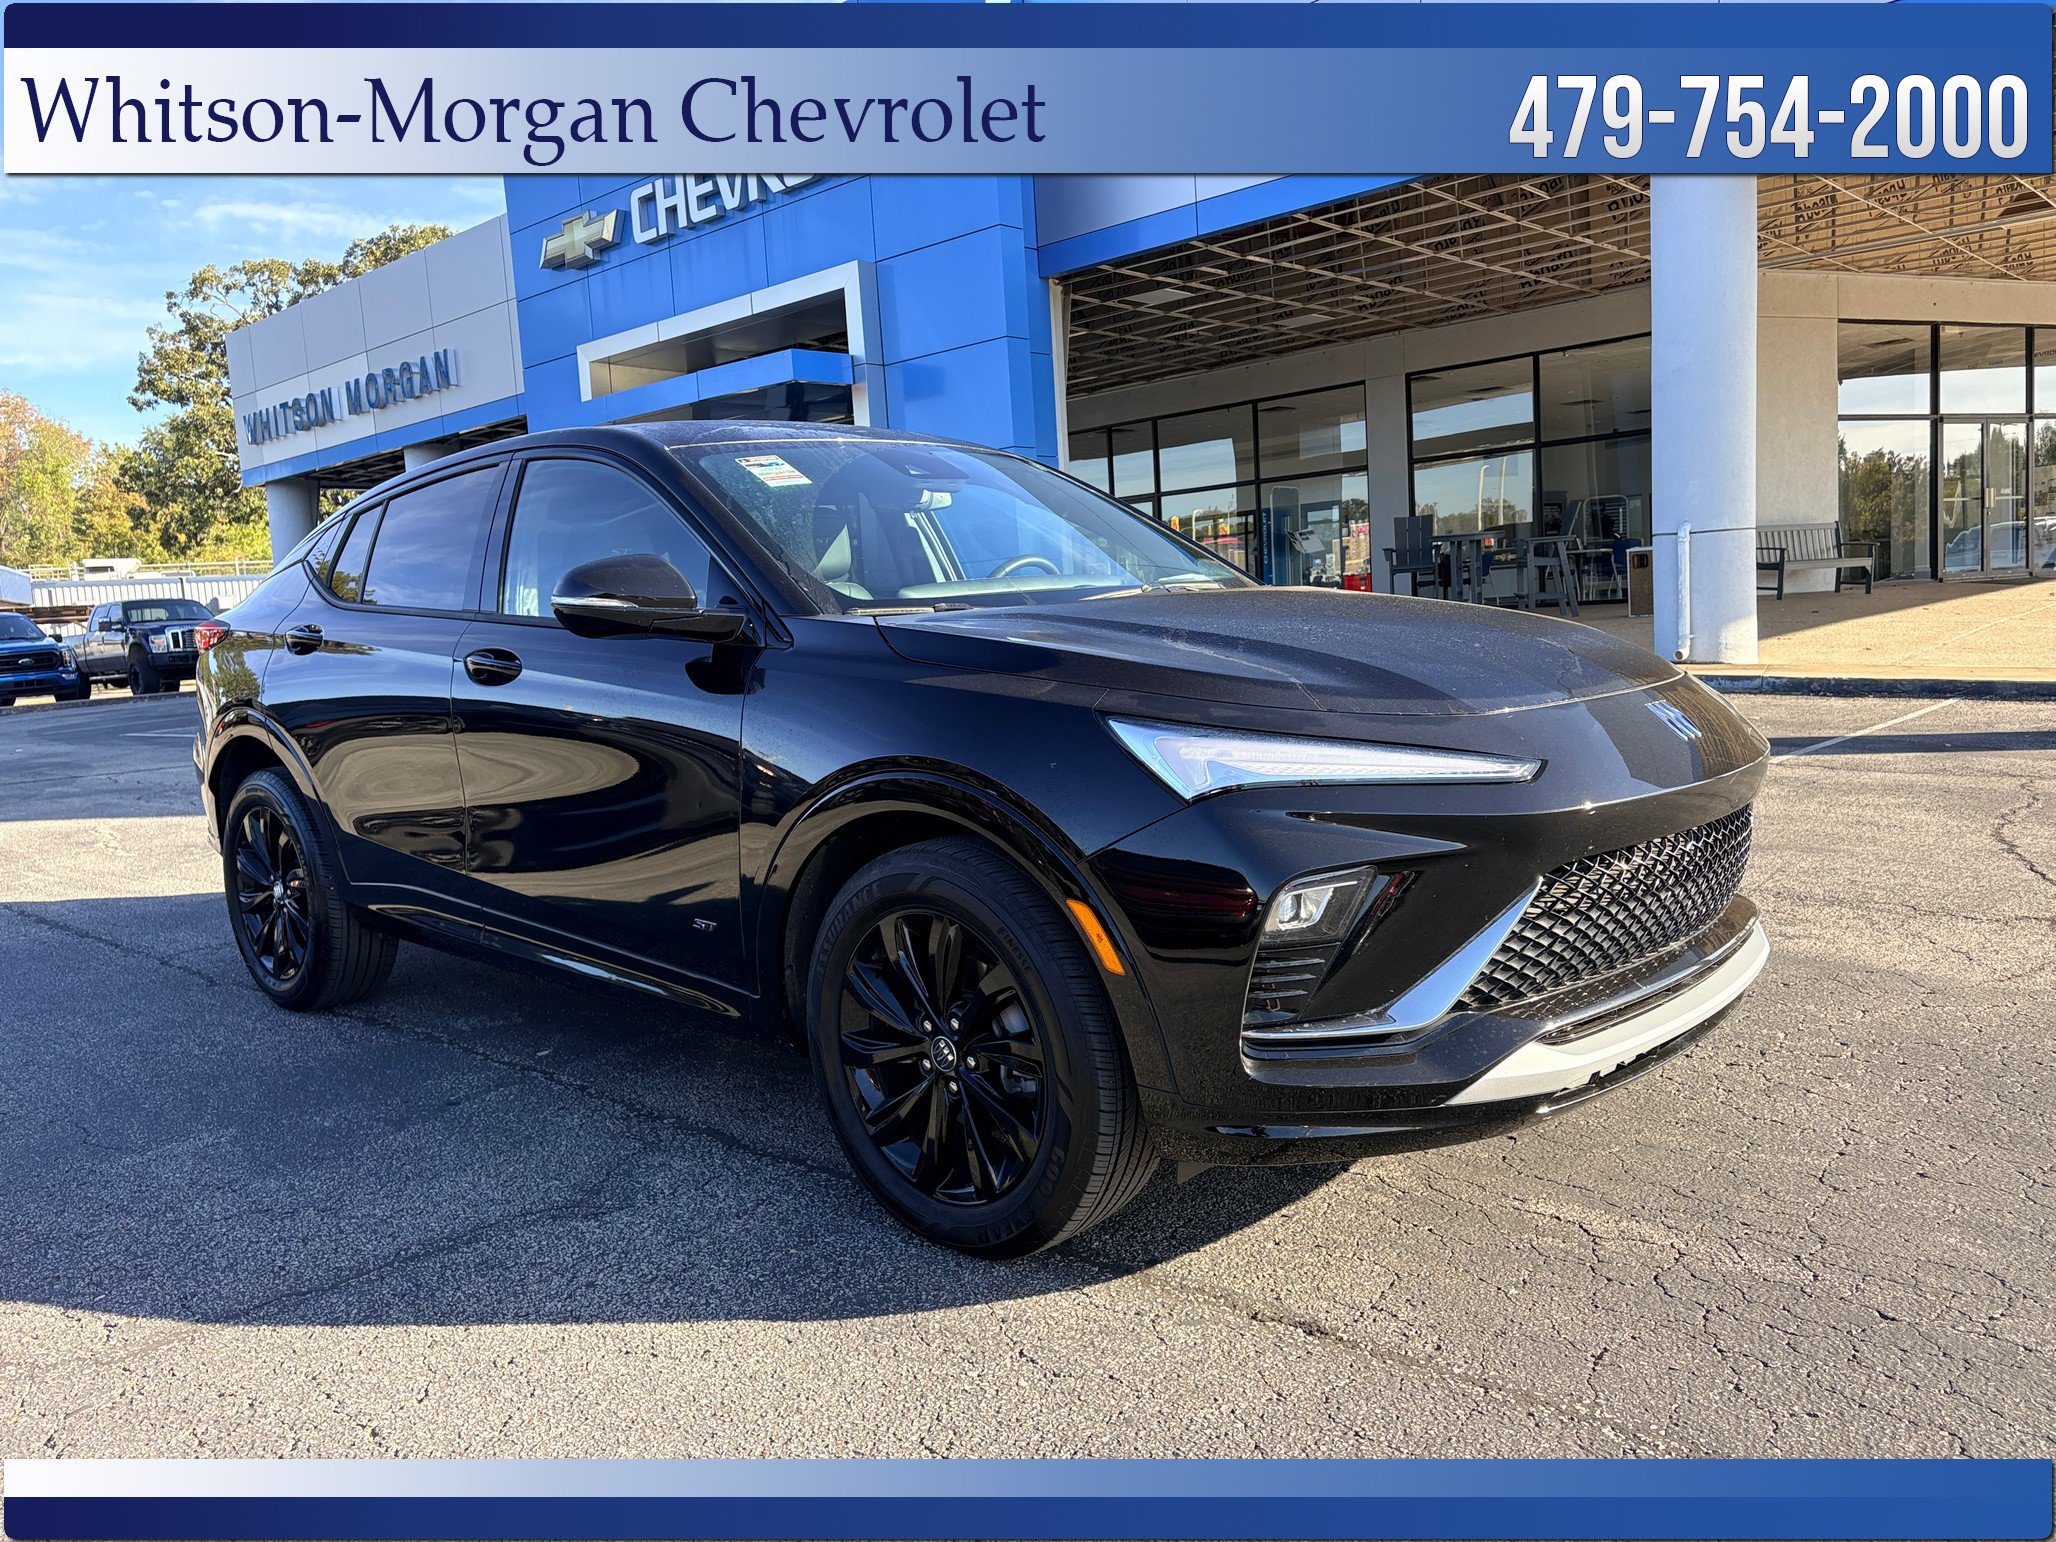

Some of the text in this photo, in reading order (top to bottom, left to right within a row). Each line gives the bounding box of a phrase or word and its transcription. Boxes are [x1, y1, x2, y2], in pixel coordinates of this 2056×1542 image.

[243, 348, 452, 446] WHITSON MORGAN
[692, 917, 718, 932] ST
